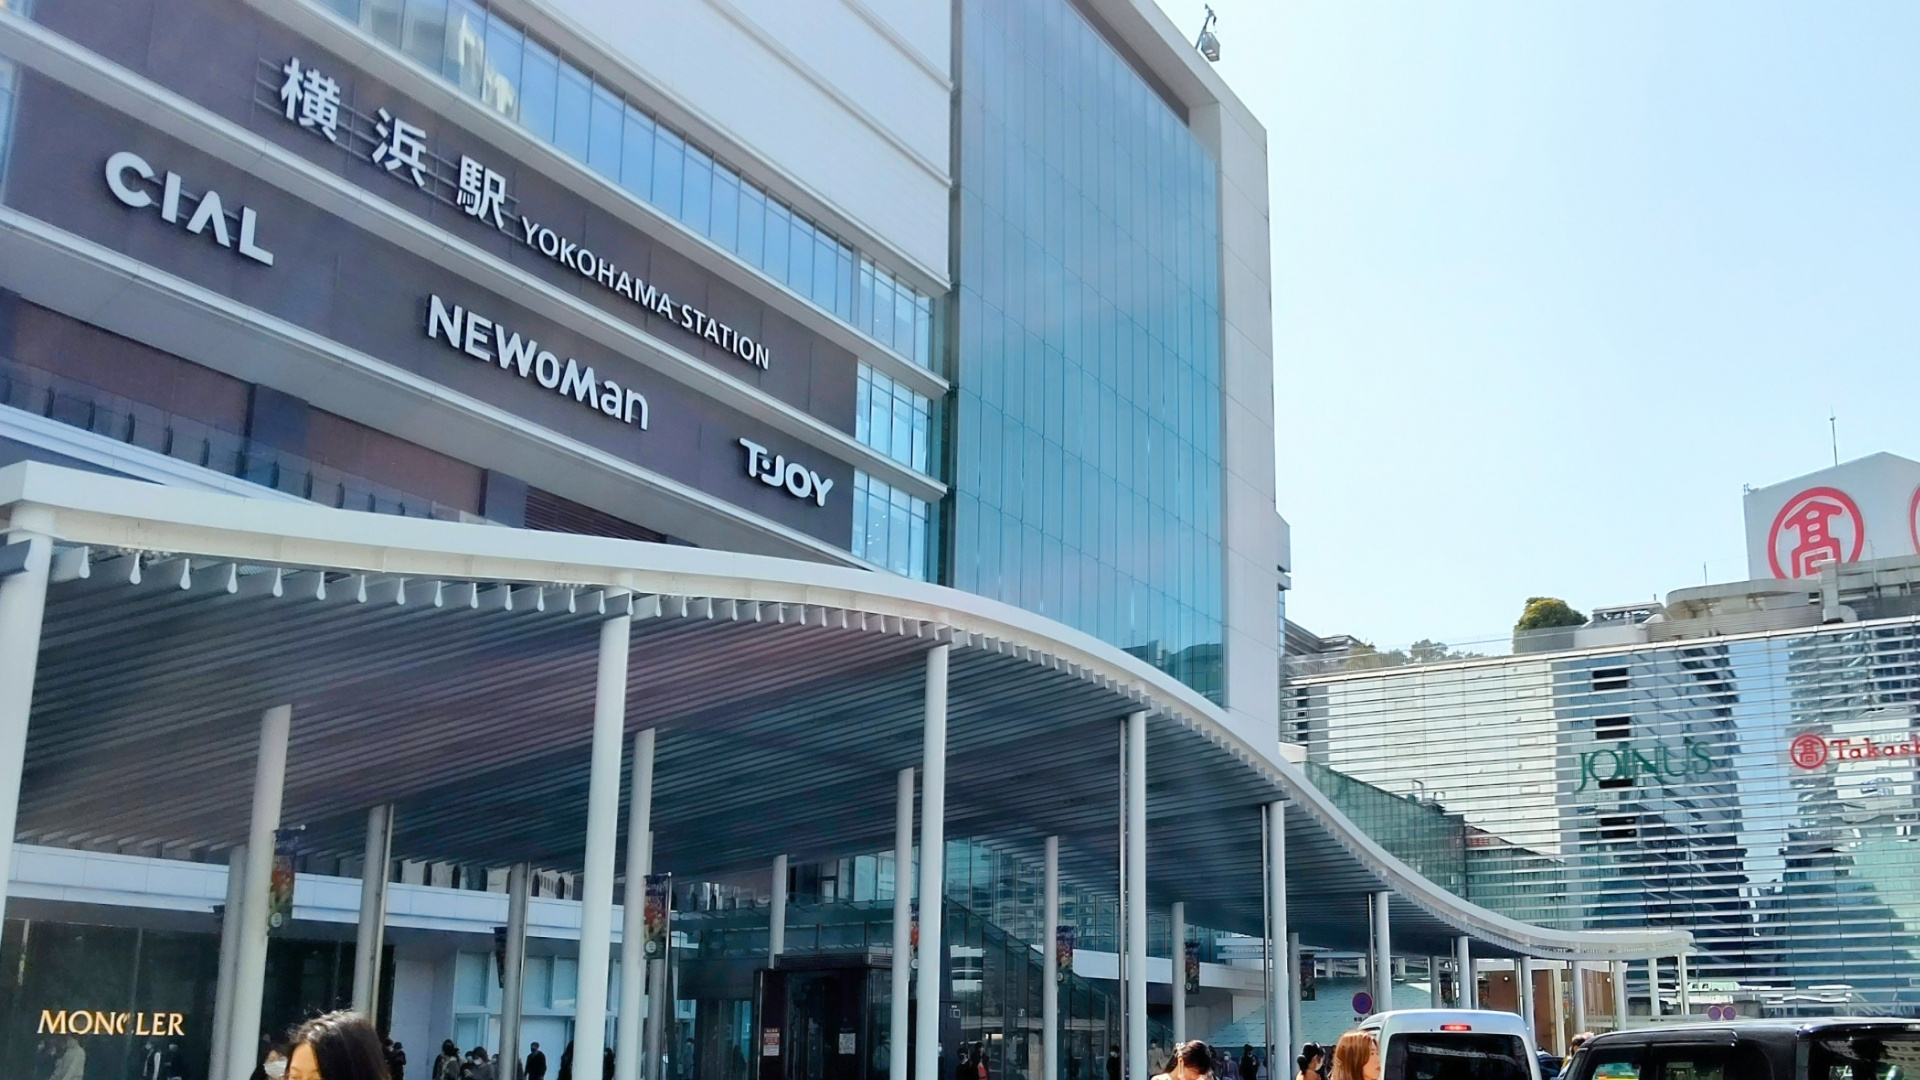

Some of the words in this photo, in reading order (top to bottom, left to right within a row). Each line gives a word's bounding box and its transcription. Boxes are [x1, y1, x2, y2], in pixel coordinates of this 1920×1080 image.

[105, 151, 274, 266] CIAL
[280, 56, 506, 229] 横浜駅
[521, 216, 673, 320] YOKOHAMA
[681, 304, 769, 370] STATION
